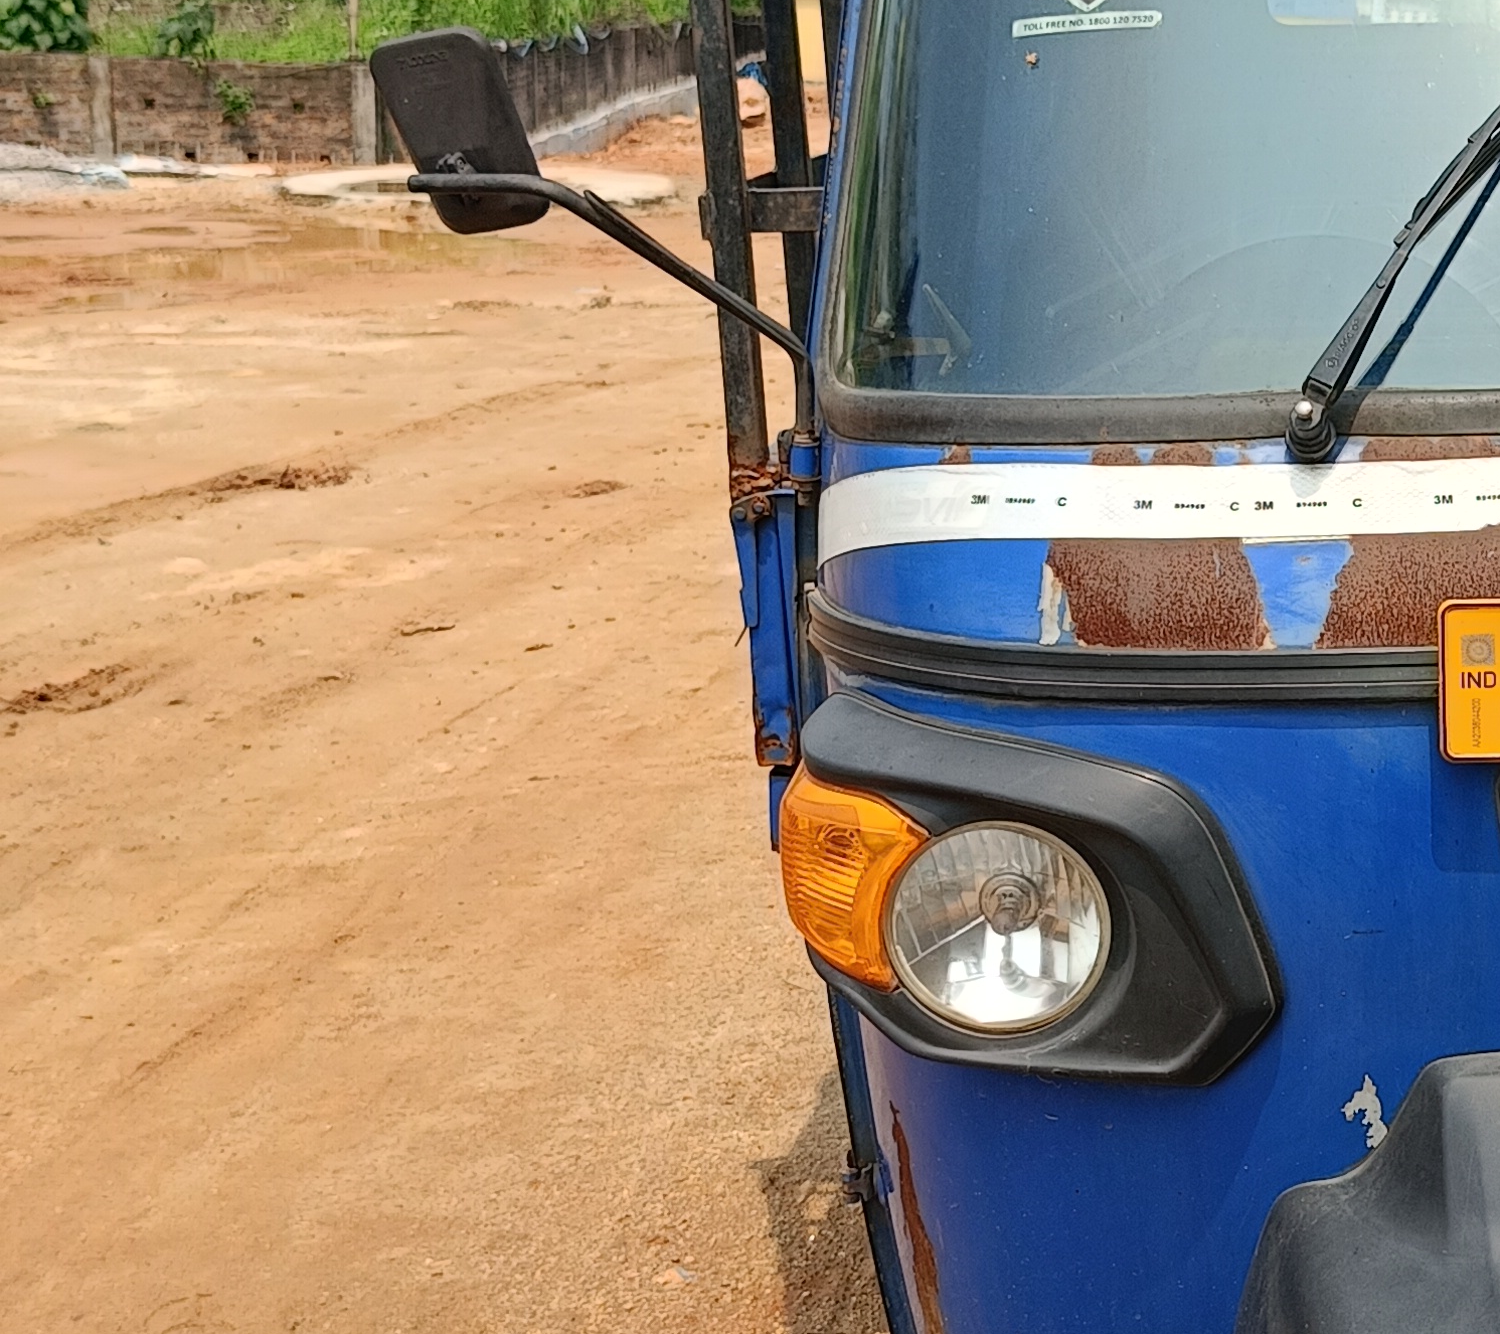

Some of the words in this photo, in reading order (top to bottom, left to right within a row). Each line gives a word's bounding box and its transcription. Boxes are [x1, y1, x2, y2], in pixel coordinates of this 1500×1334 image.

[1023, 22, 1043, 32] TOLL
[1046, 20, 1066, 29] FREE
[1089, 17, 1111, 26] 1800
[1056, 496, 1068, 507] C
[1133, 499, 1153, 510] 3M
[1229, 501, 1240, 512] C
[1254, 500, 1274, 511] 3M
[1352, 498, 1363, 508] C
[1433, 494, 1453, 505] 3M
[1460, 671, 1497, 689] IND
